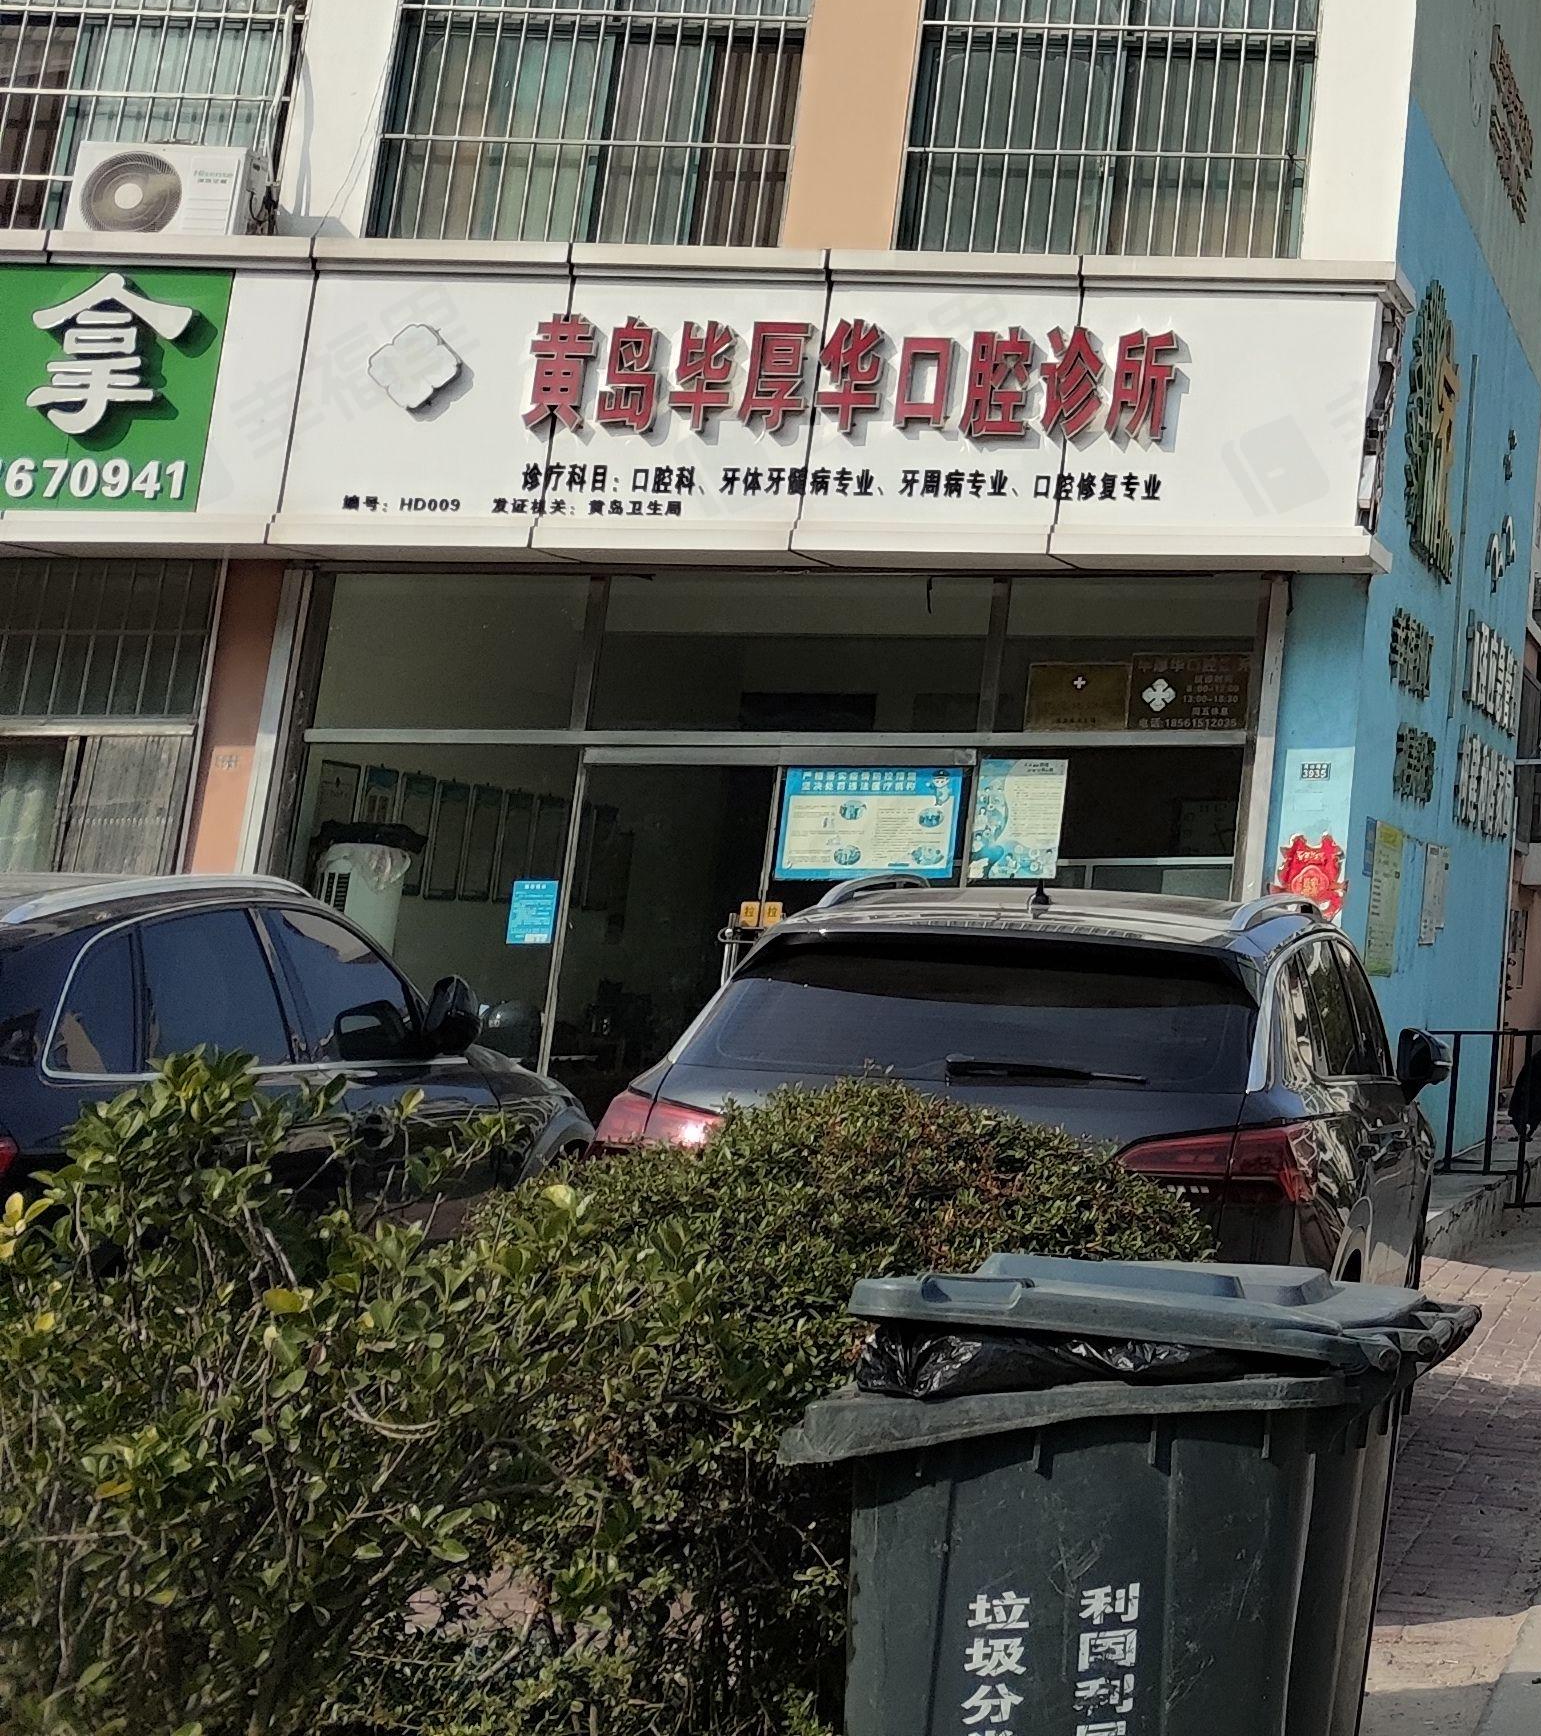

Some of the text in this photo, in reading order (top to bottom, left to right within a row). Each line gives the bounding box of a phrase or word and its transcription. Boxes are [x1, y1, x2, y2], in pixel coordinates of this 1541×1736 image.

[26, 272, 193, 434] 拿
[521, 312, 1180, 442] 黄岛毕厚华口腔诊所
[0, 459, 187, 501] 670941
